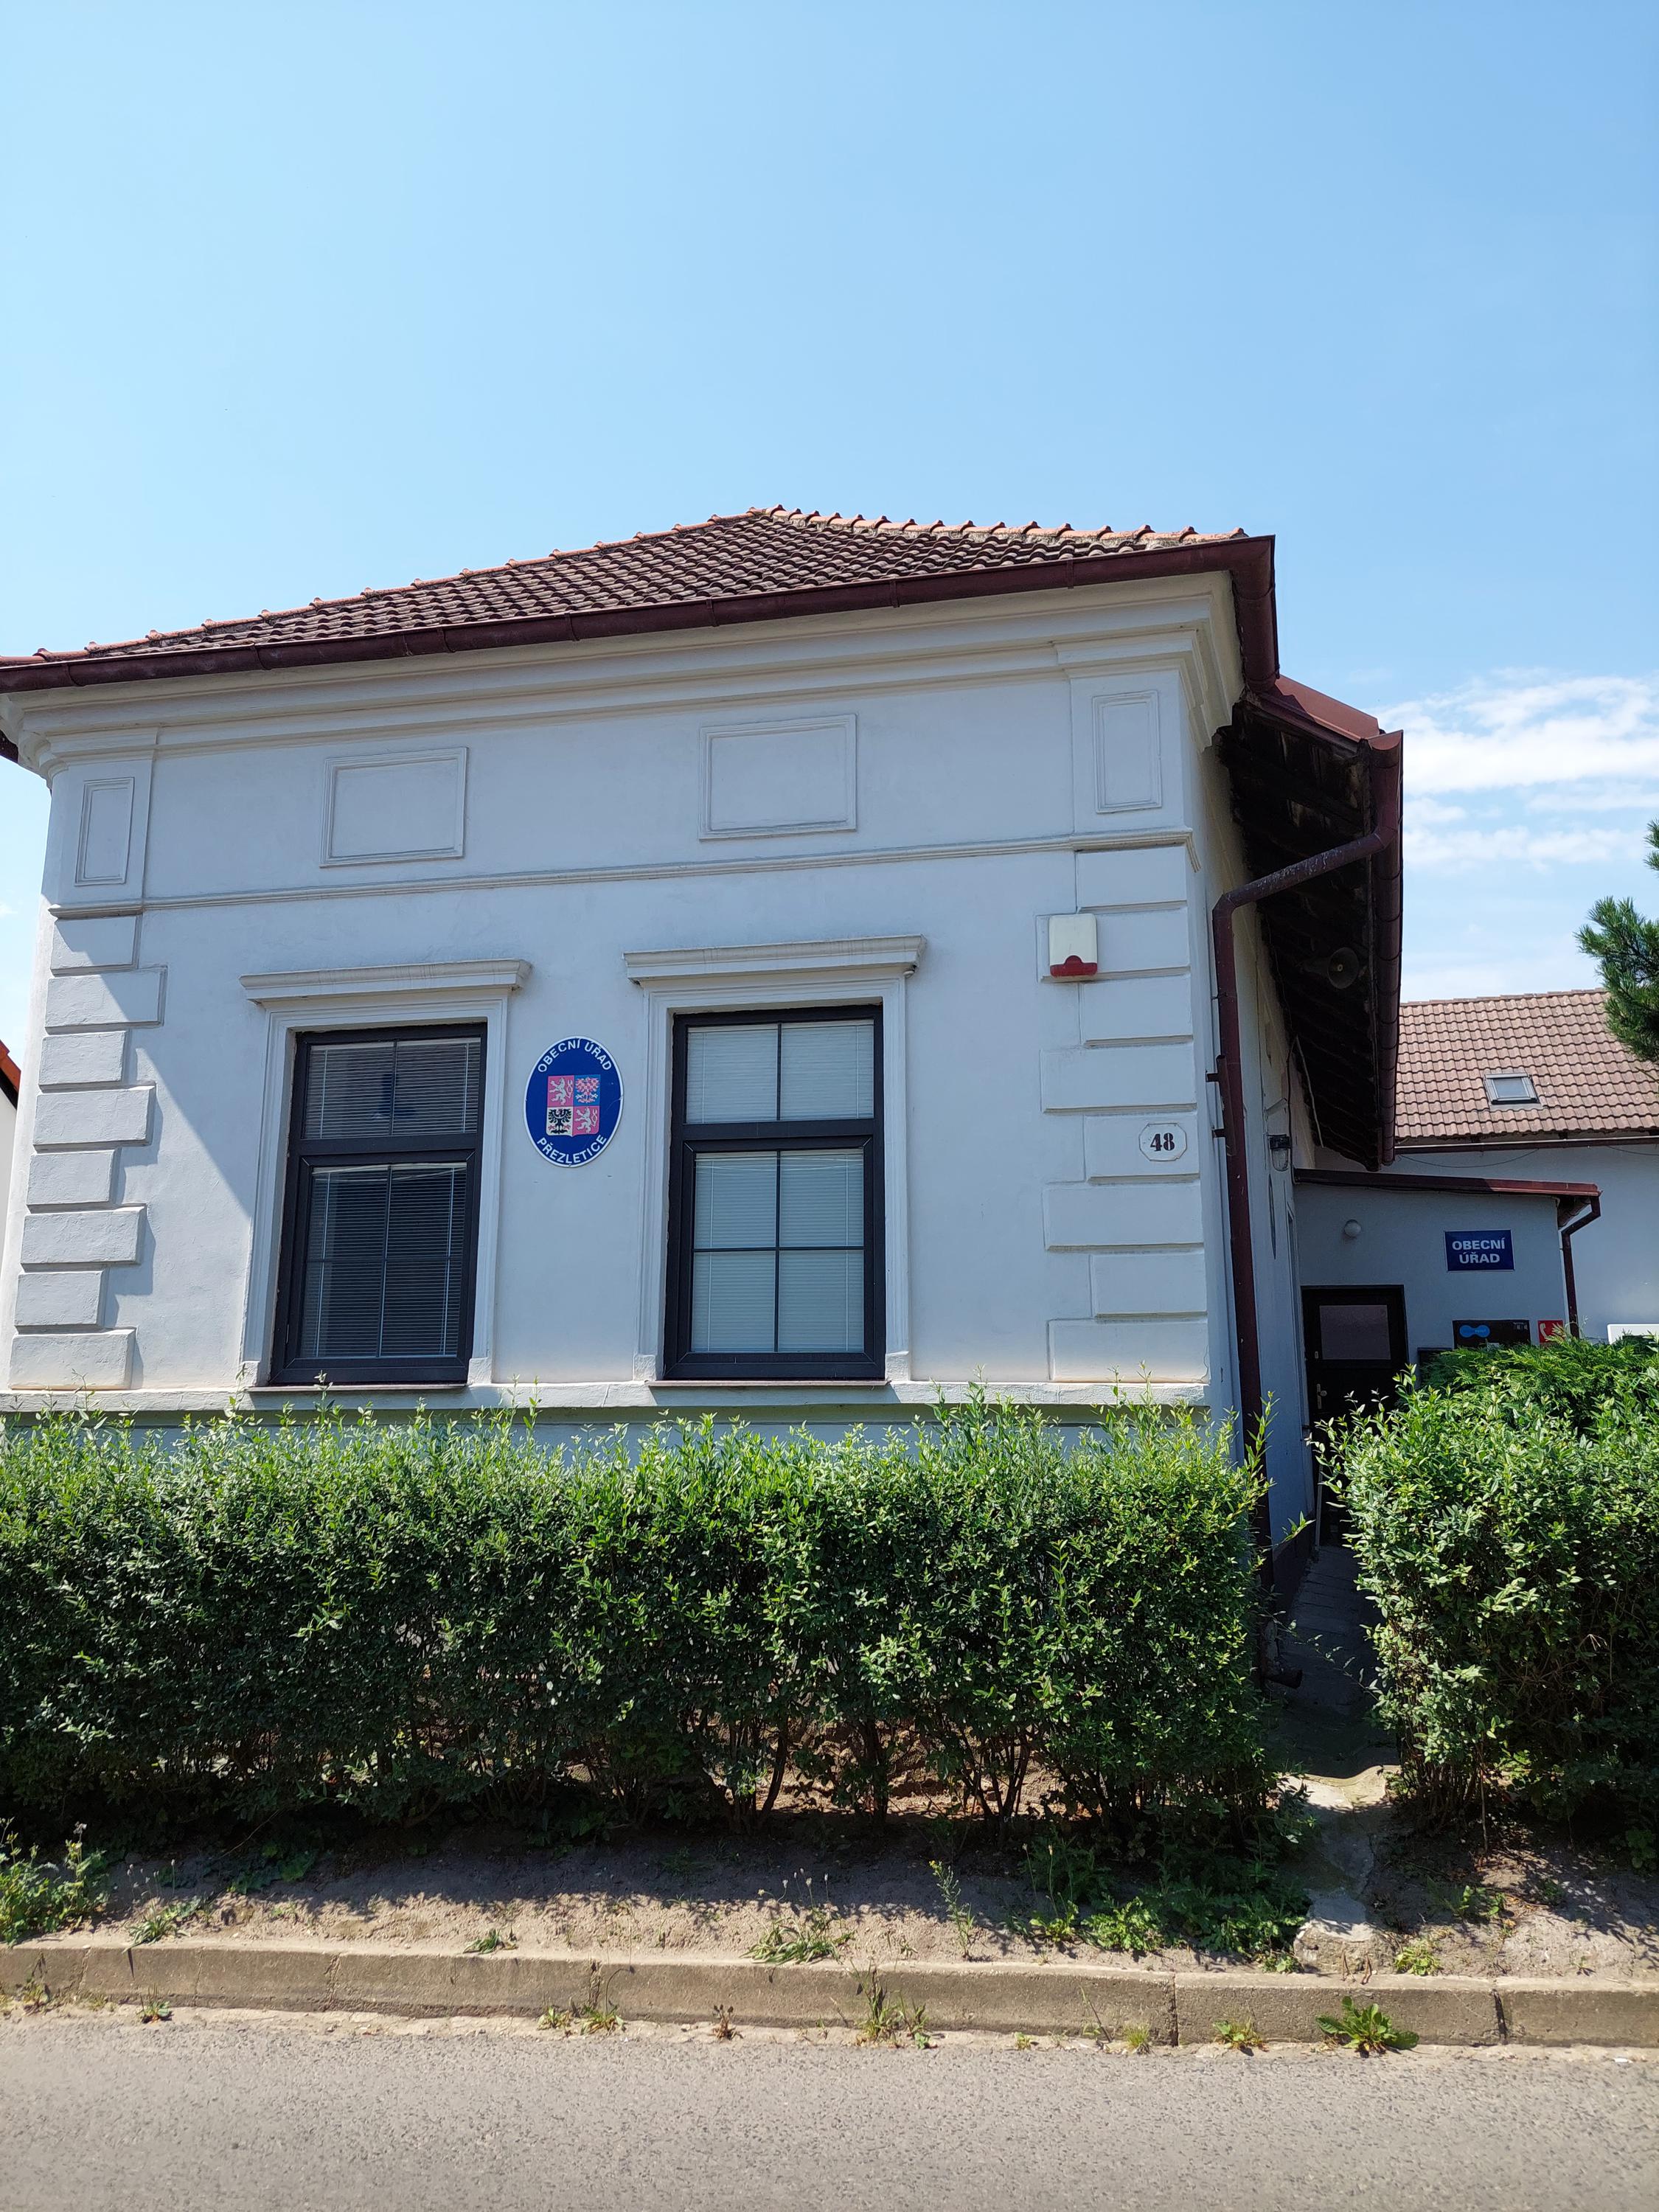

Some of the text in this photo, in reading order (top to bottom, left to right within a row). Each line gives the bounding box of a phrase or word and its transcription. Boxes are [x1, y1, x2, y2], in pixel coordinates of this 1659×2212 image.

[538, 1038, 612, 1073] OBECNÍ ÚŘAD
[537, 1134, 607, 1164] PŘEZLETICE
[1150, 1133, 1175, 1152] 48
[1452, 1237, 1506, 1251] OBECNÍ
[1459, 1251, 1500, 1264] ÚŘAD
